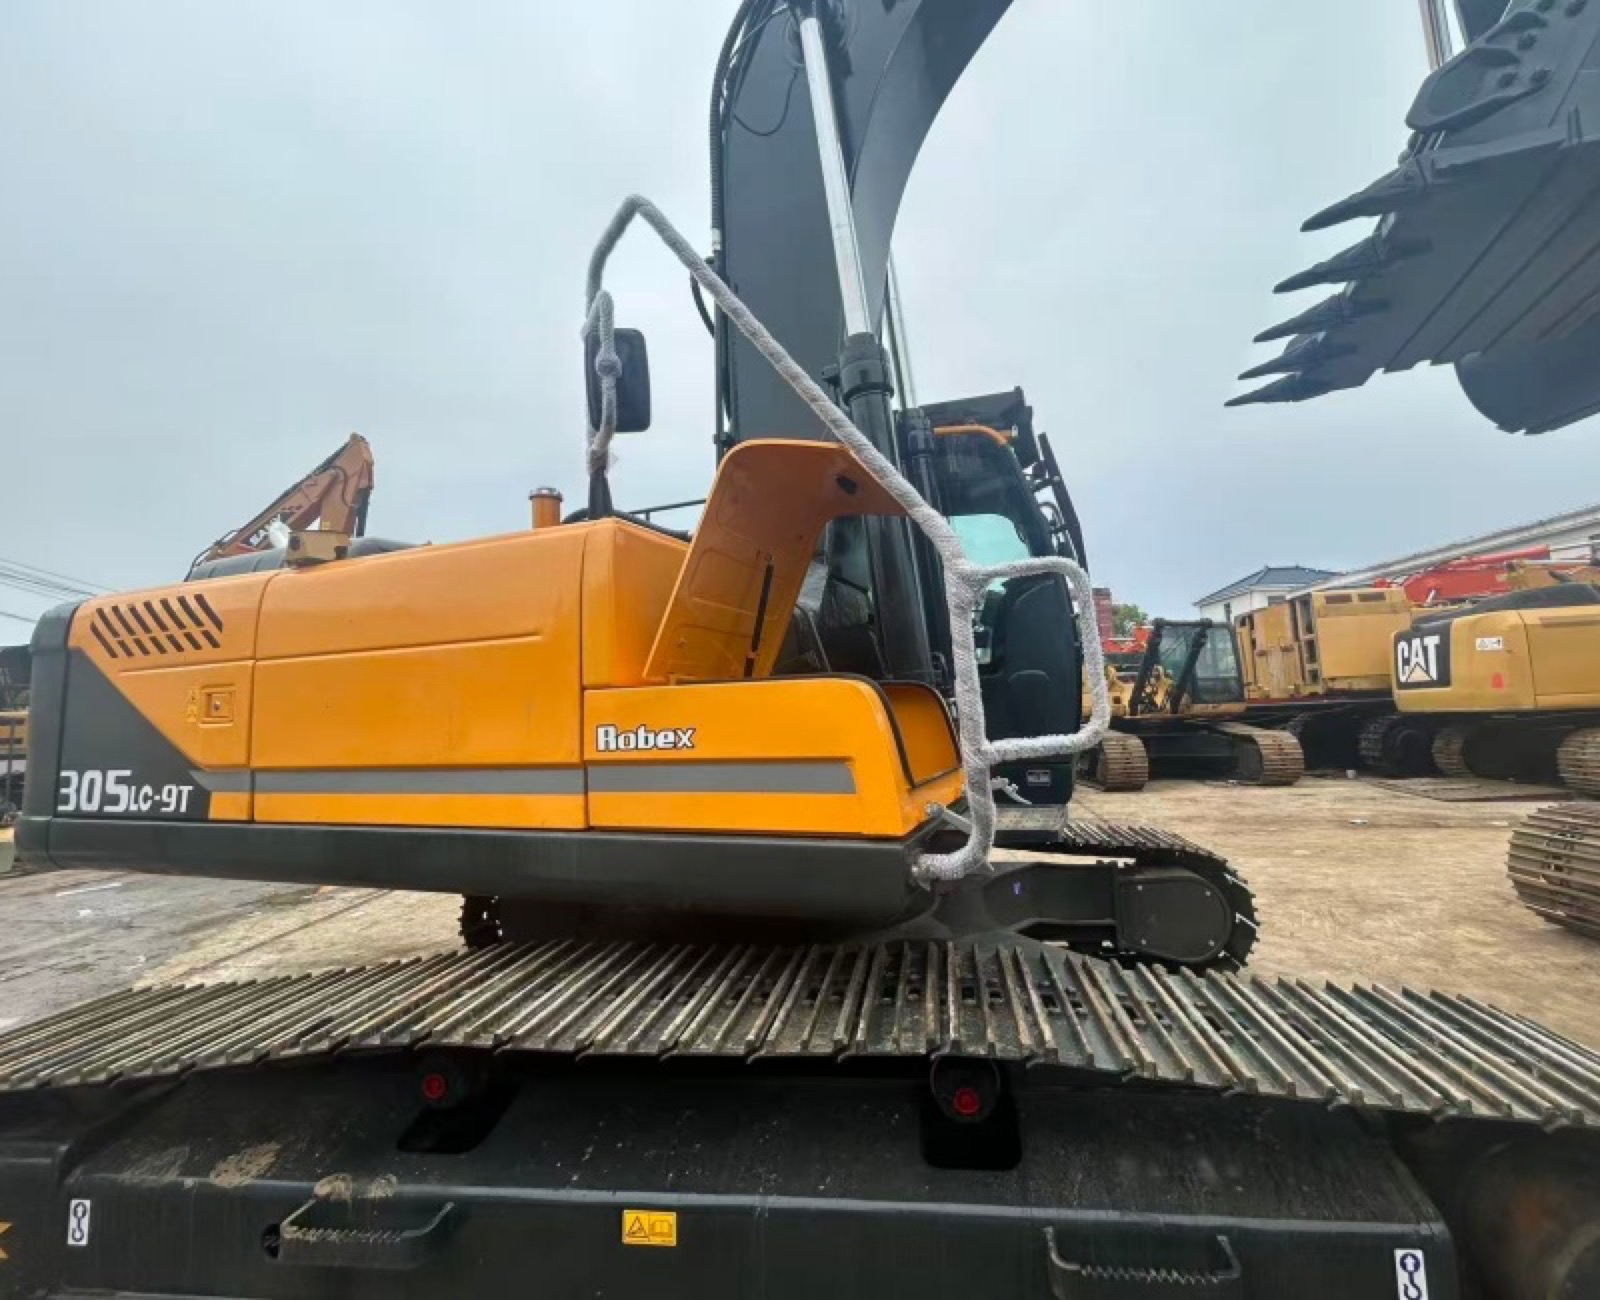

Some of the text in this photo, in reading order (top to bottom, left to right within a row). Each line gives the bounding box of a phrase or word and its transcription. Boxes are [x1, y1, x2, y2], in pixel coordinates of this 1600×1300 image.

[1397, 635, 1441, 683] CAT
[596, 724, 696, 752] Robex
[57, 769, 194, 813] 305LC-9T
